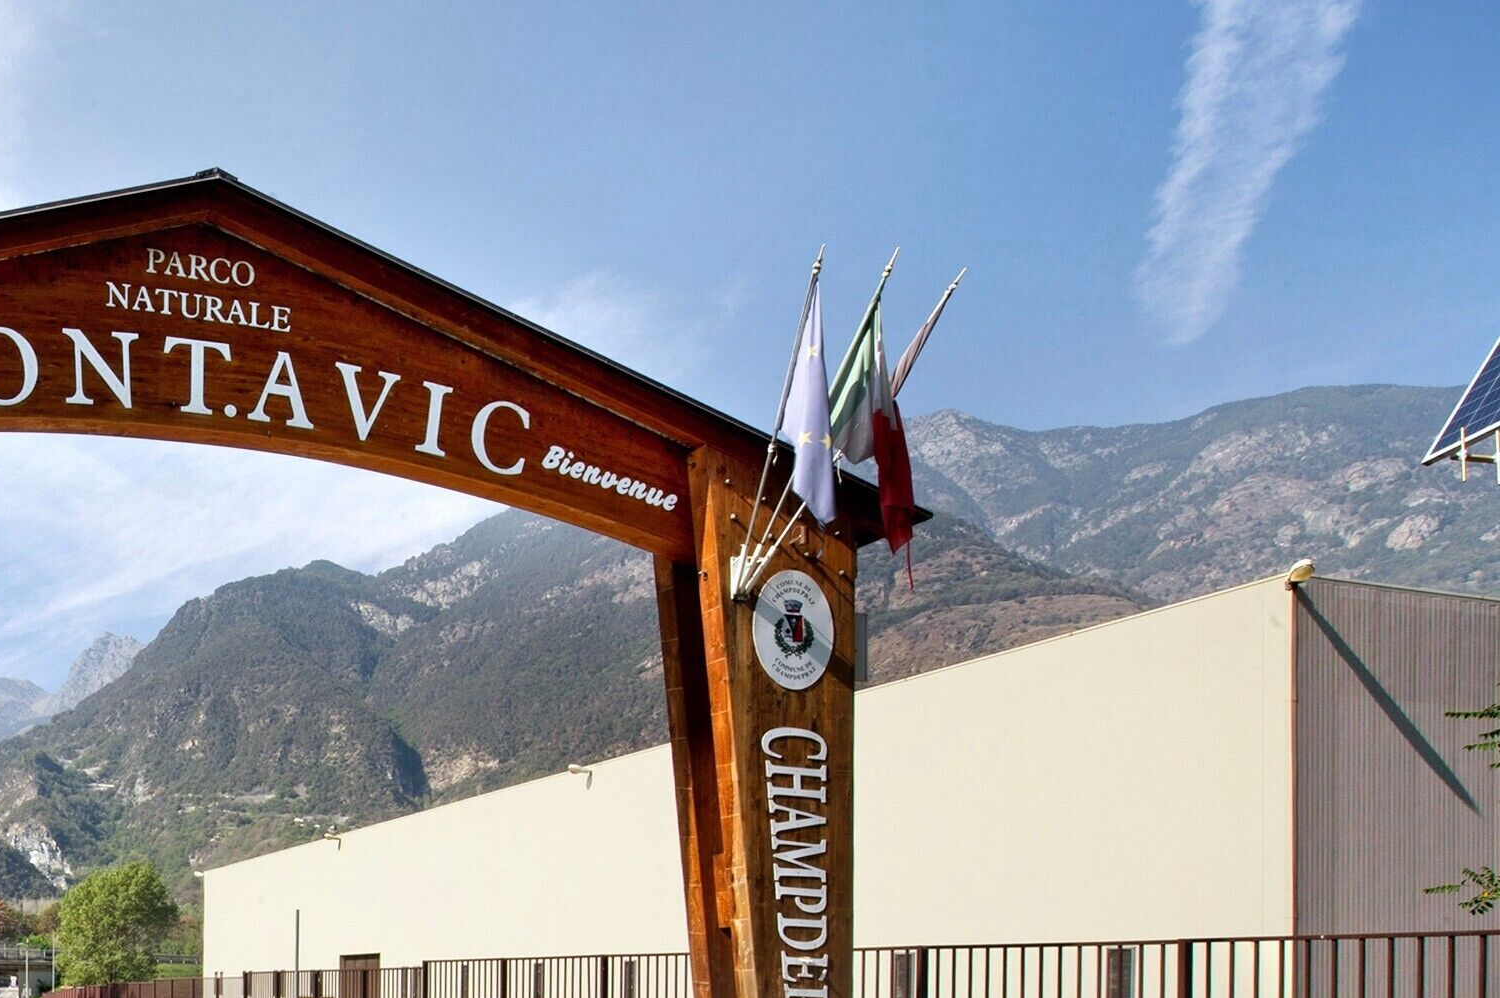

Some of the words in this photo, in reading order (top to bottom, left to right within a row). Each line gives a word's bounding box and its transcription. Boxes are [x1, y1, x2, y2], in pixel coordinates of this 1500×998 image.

[146, 248, 256, 287] PARCO
[105, 281, 292, 333] NATURALE
[541, 445, 678, 511] Bienvenue
